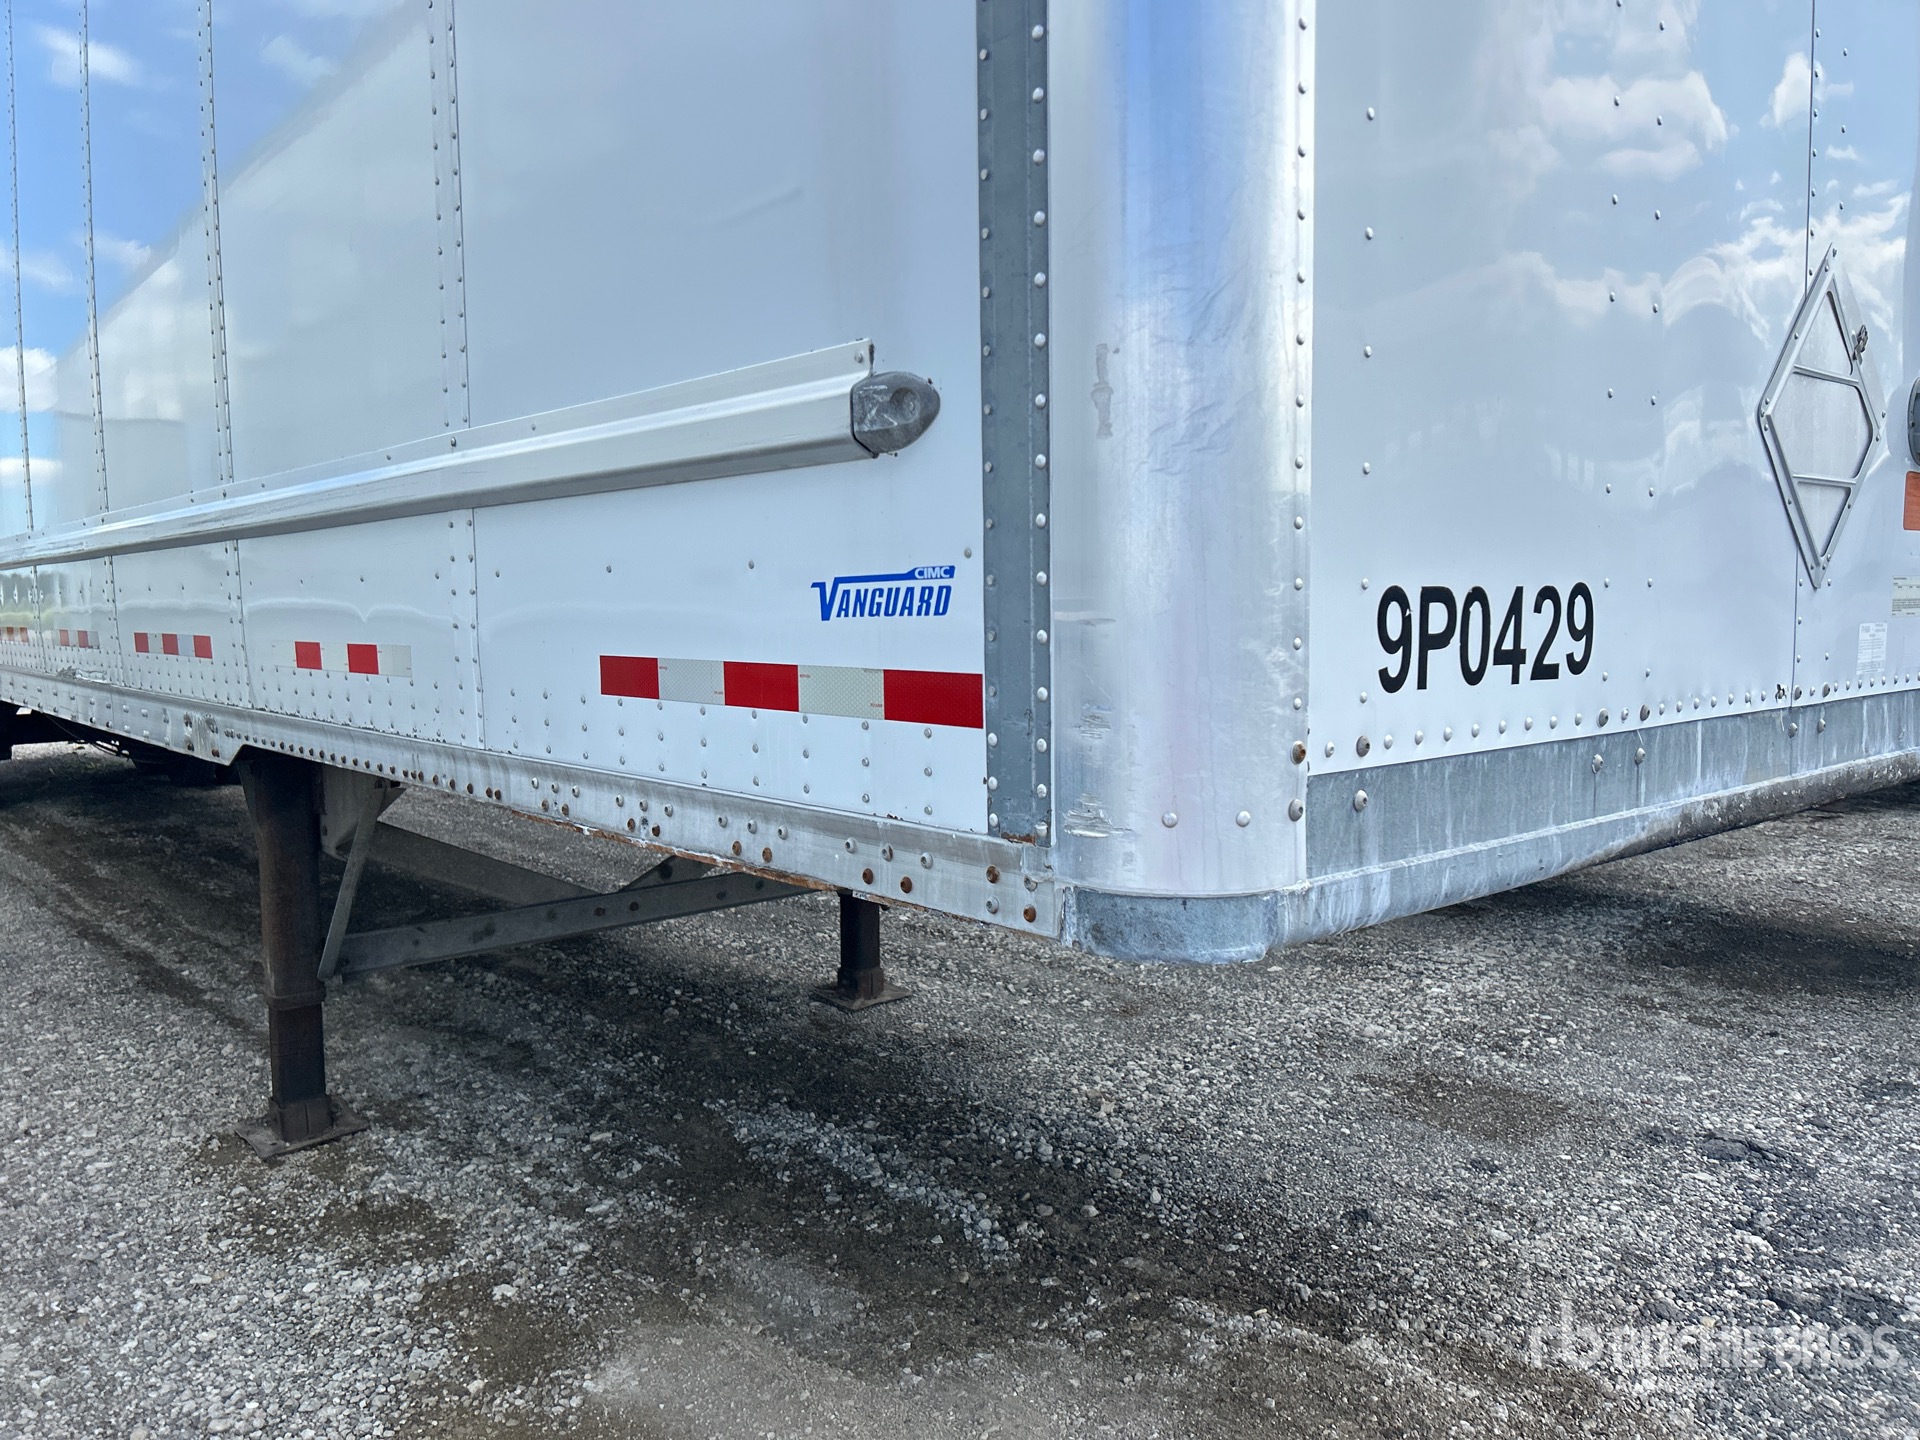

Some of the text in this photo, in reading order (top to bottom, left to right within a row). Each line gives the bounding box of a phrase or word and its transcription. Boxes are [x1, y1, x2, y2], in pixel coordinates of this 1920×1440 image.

[914, 566, 951, 579] CIMC
[811, 577, 952, 621] VANGUARD
[1377, 581, 1594, 694] 9P0429
